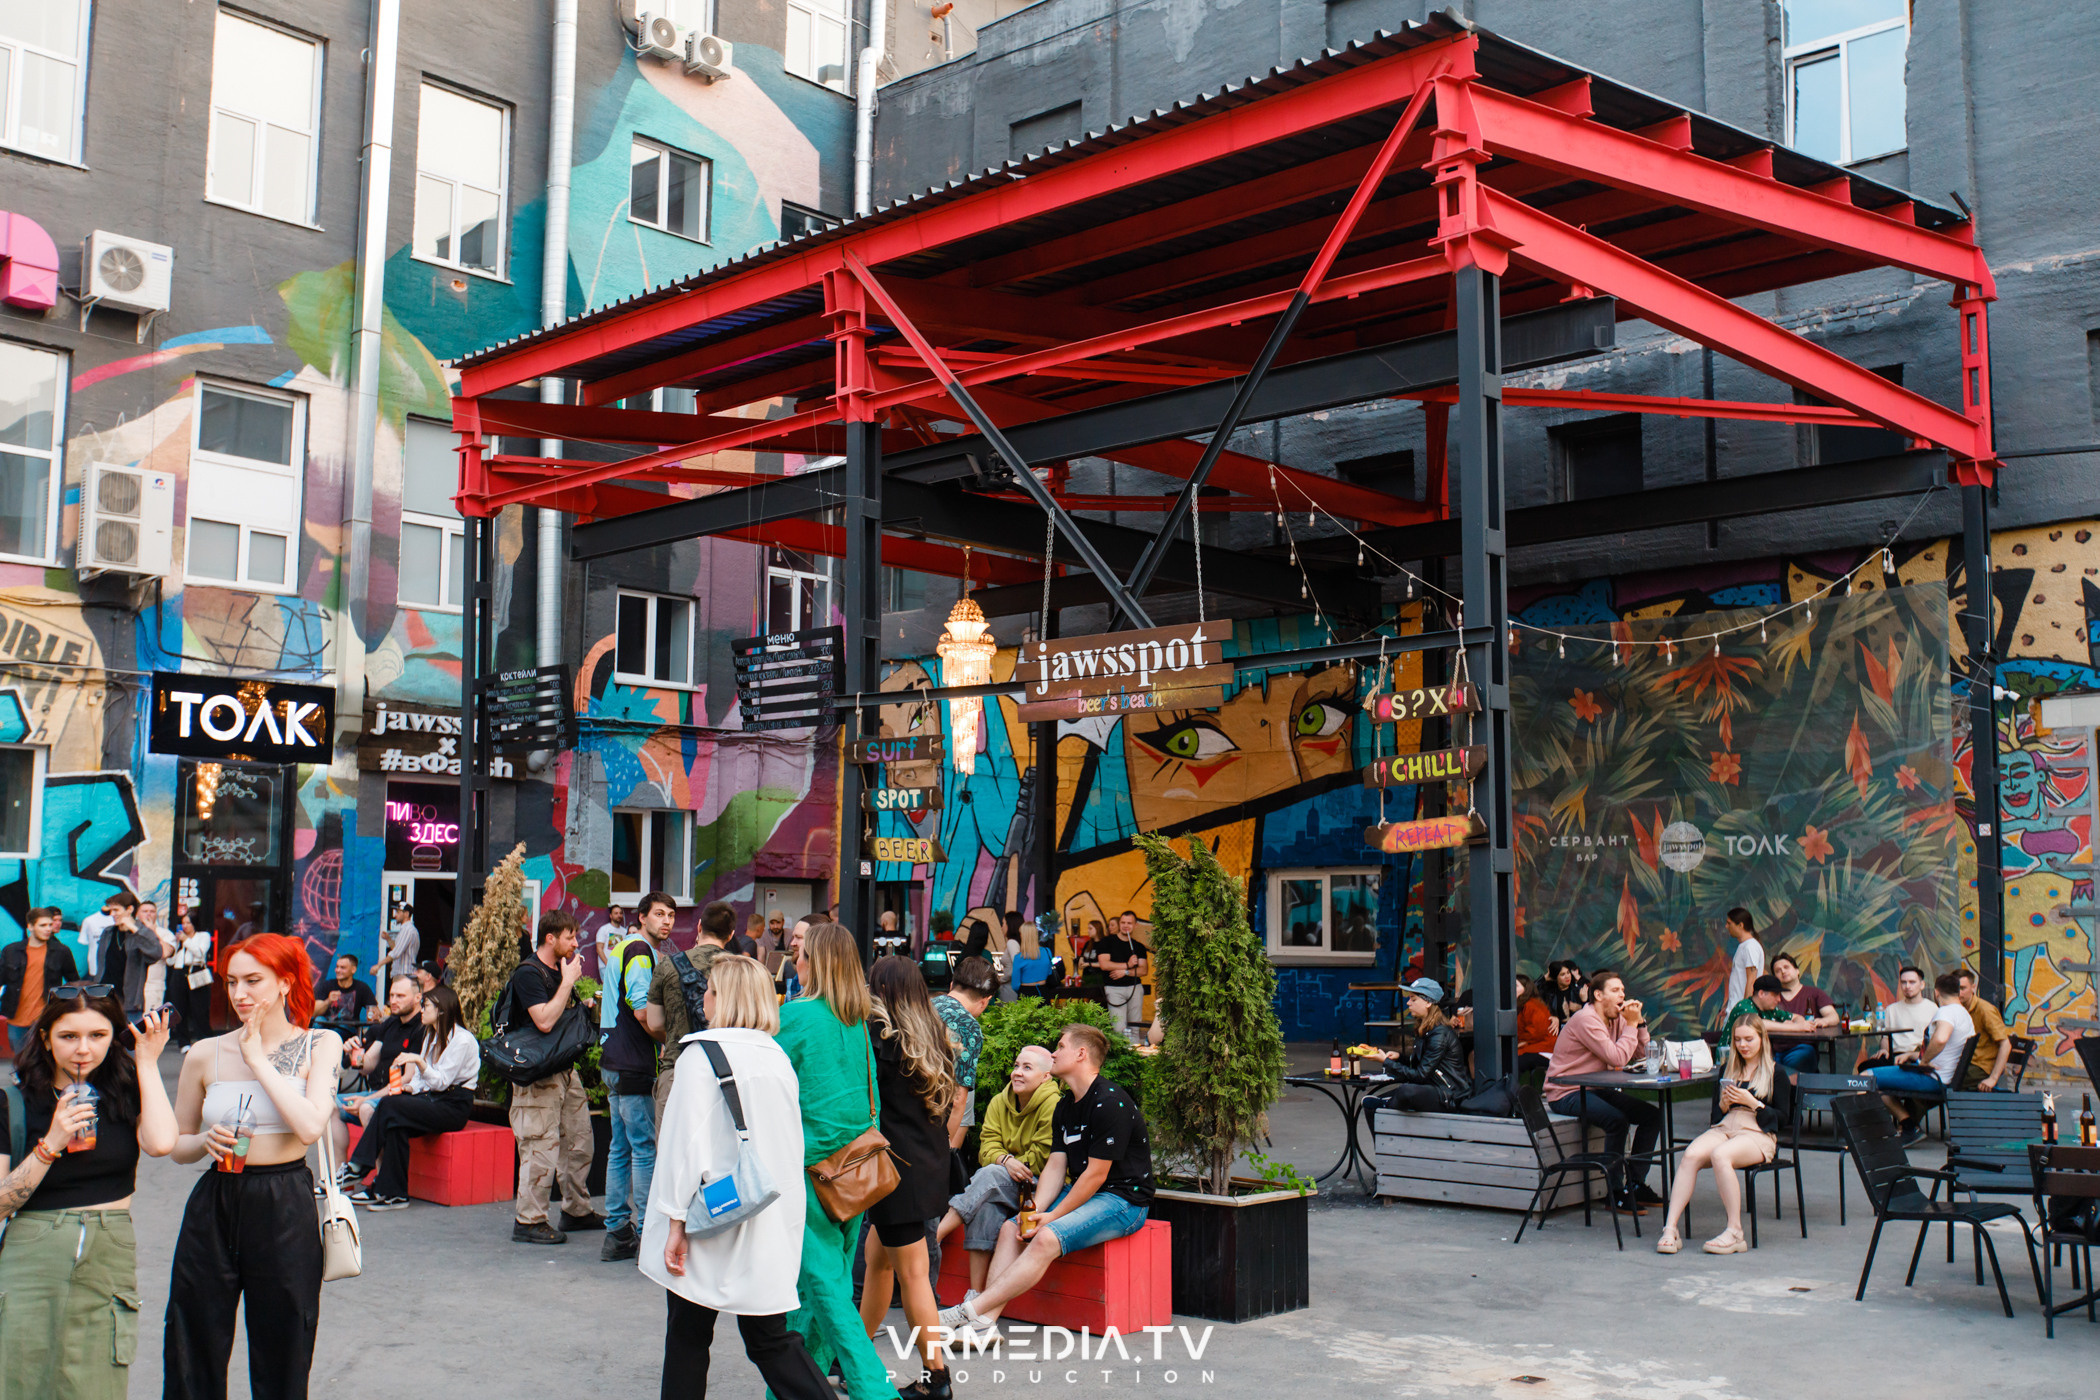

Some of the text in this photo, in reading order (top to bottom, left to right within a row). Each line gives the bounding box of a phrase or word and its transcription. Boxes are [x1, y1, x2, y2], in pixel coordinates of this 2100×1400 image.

[1036, 626, 1208, 696] jawsspot
[1121, 683, 1163, 709] beach
[1392, 752, 1462, 782] CHILL
[876, 789, 920, 809] SPOT
[386, 801, 437, 822] ПИВО
[1396, 823, 1456, 850] REPEAT
[1549, 835, 1629, 848] СЕРВАНТ
[879, 841, 930, 860] BEER
[1576, 853, 1598, 862] БАР
